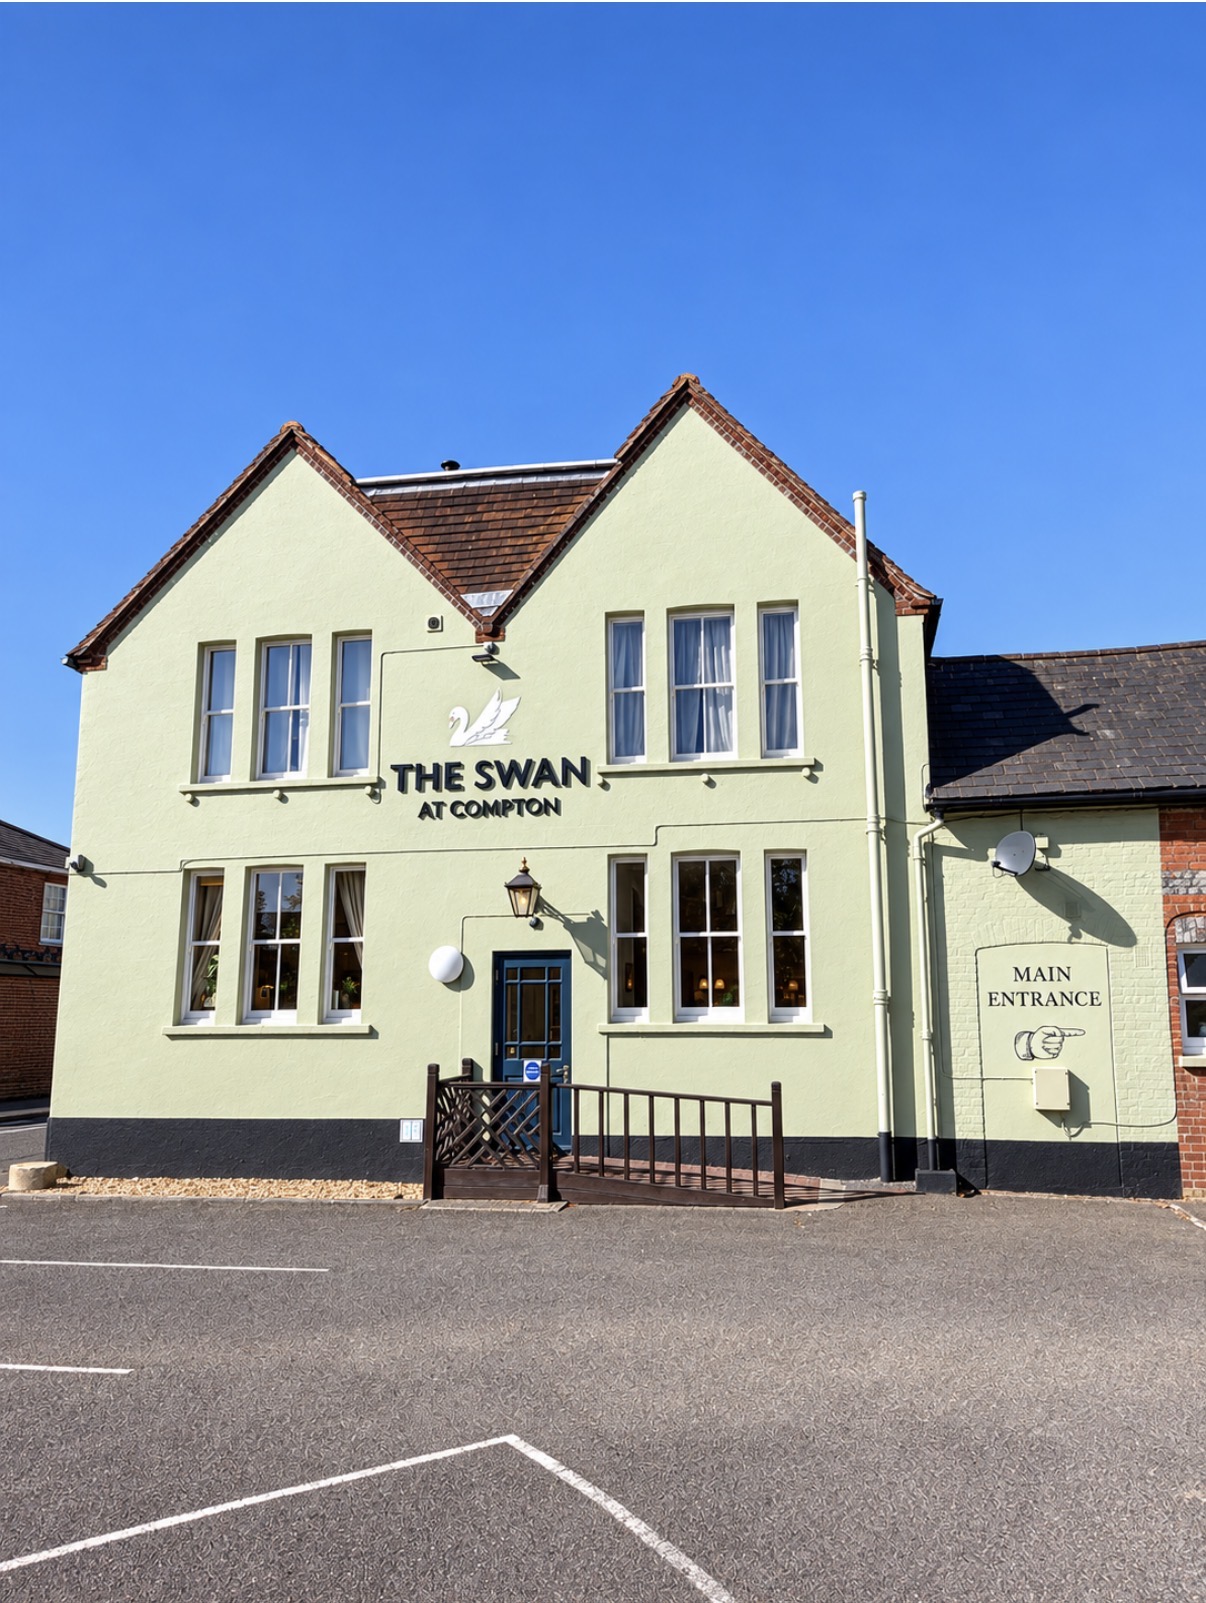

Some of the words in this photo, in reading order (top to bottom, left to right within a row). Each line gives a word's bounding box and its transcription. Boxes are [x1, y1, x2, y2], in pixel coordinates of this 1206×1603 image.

[390, 761, 464, 794] THE
[474, 756, 590, 790] SWAN
[418, 801, 447, 820] AT
[449, 797, 561, 818] COMPTON
[1013, 966, 1072, 982] MAIN
[988, 991, 1102, 1007] ENTRANCE
